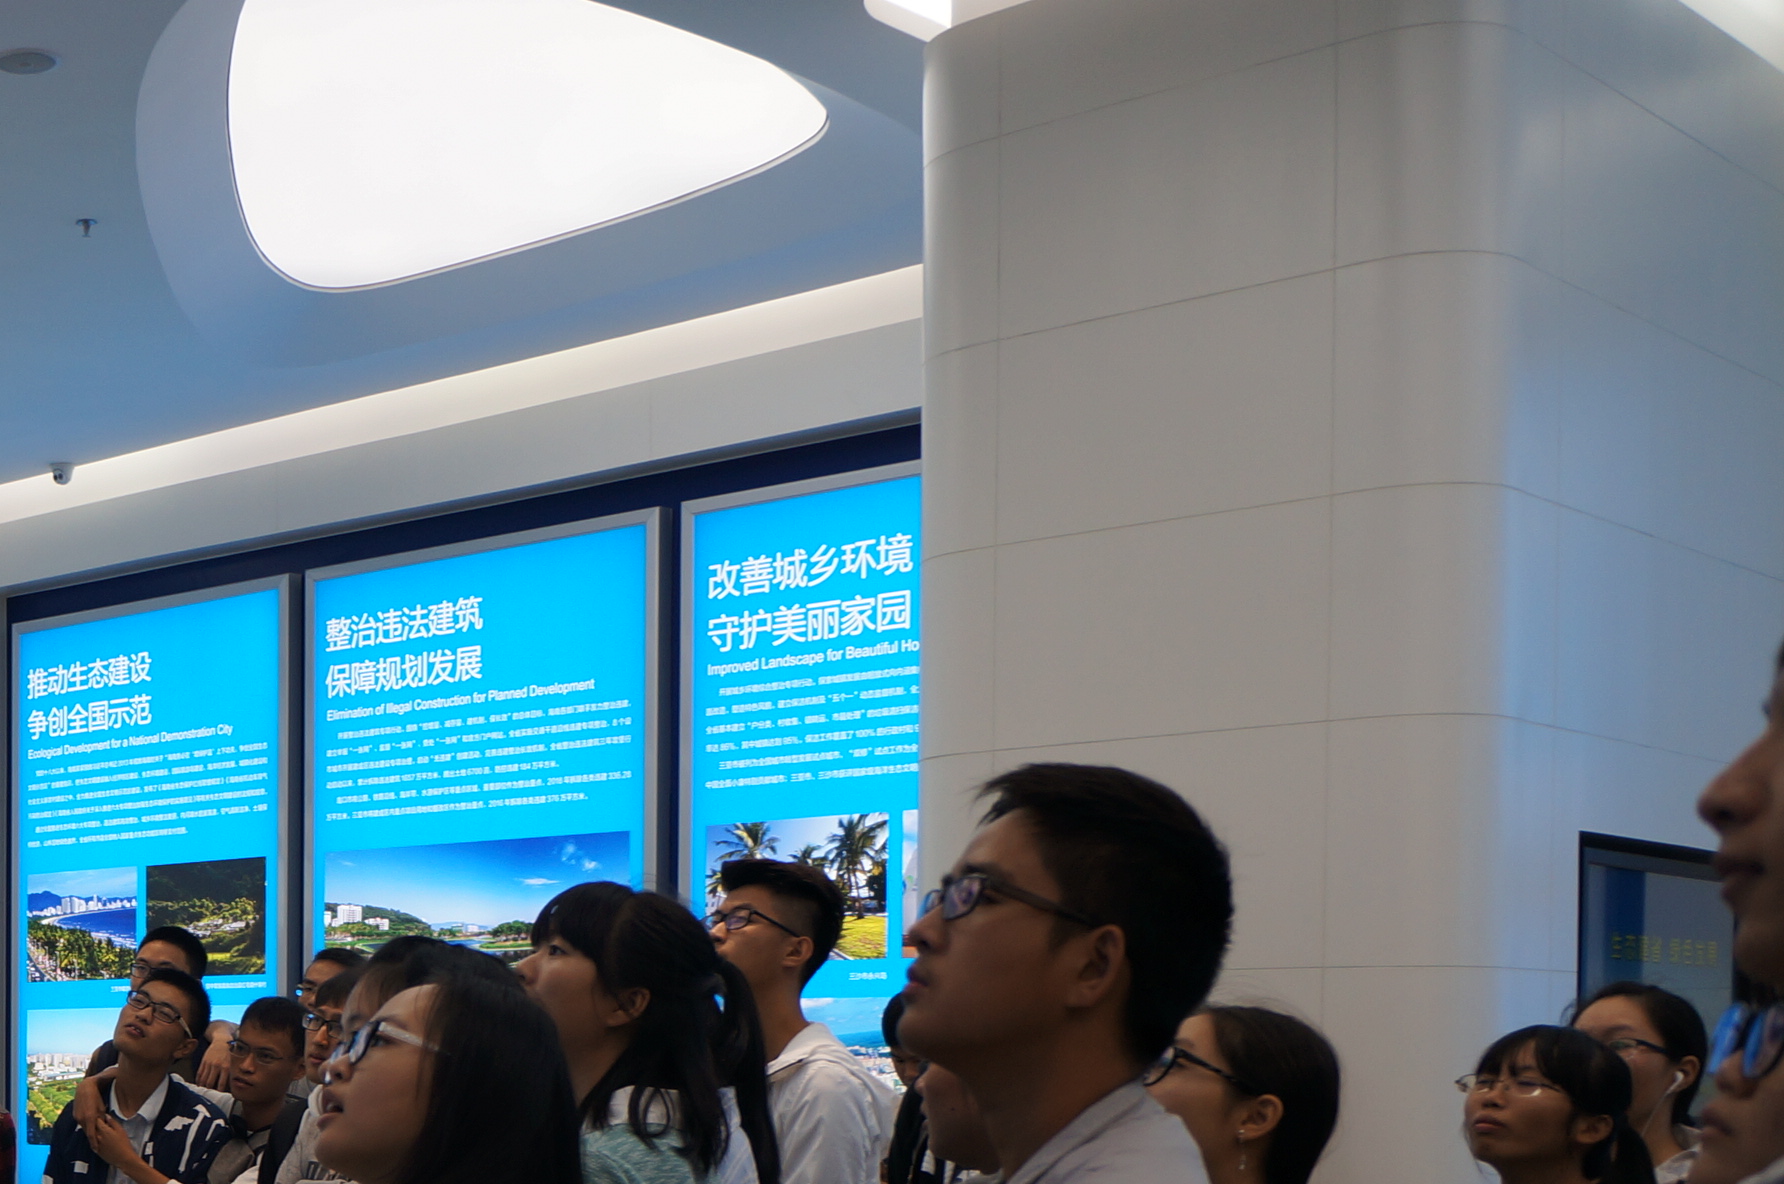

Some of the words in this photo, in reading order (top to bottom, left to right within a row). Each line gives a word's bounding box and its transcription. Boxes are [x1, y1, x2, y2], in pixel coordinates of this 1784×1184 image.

[708, 532, 914, 600] 改善城乡环境
[325, 595, 484, 653] 整治违法建筑
[707, 589, 911, 652] 守护美丽家园
[27, 651, 152, 700] 推动生态建设
[325, 645, 483, 699] 保障规划发展
[708, 659, 759, 676] Improved
[761, 653, 825, 669] Landscape
[826, 649, 844, 661] for
[845, 641, 898, 659] Beautiful
[27, 693, 152, 740] 争创全国示范
[327, 707, 374, 721] Elimination
[375, 704, 385, 715] of
[386, 701, 412, 715] Illegal
[414, 695, 471, 710] Construction
[473, 692, 486, 703] for
[488, 687, 528, 701] Planned
[529, 679, 595, 696] Development
[28, 746, 63, 759] Ecological
[64, 740, 111, 754] Development
[111, 739, 122, 748] for
[122, 739, 129, 747] a
[129, 733, 160, 746] National
[161, 727, 216, 742] Demonstration
[217, 724, 233, 735] City
